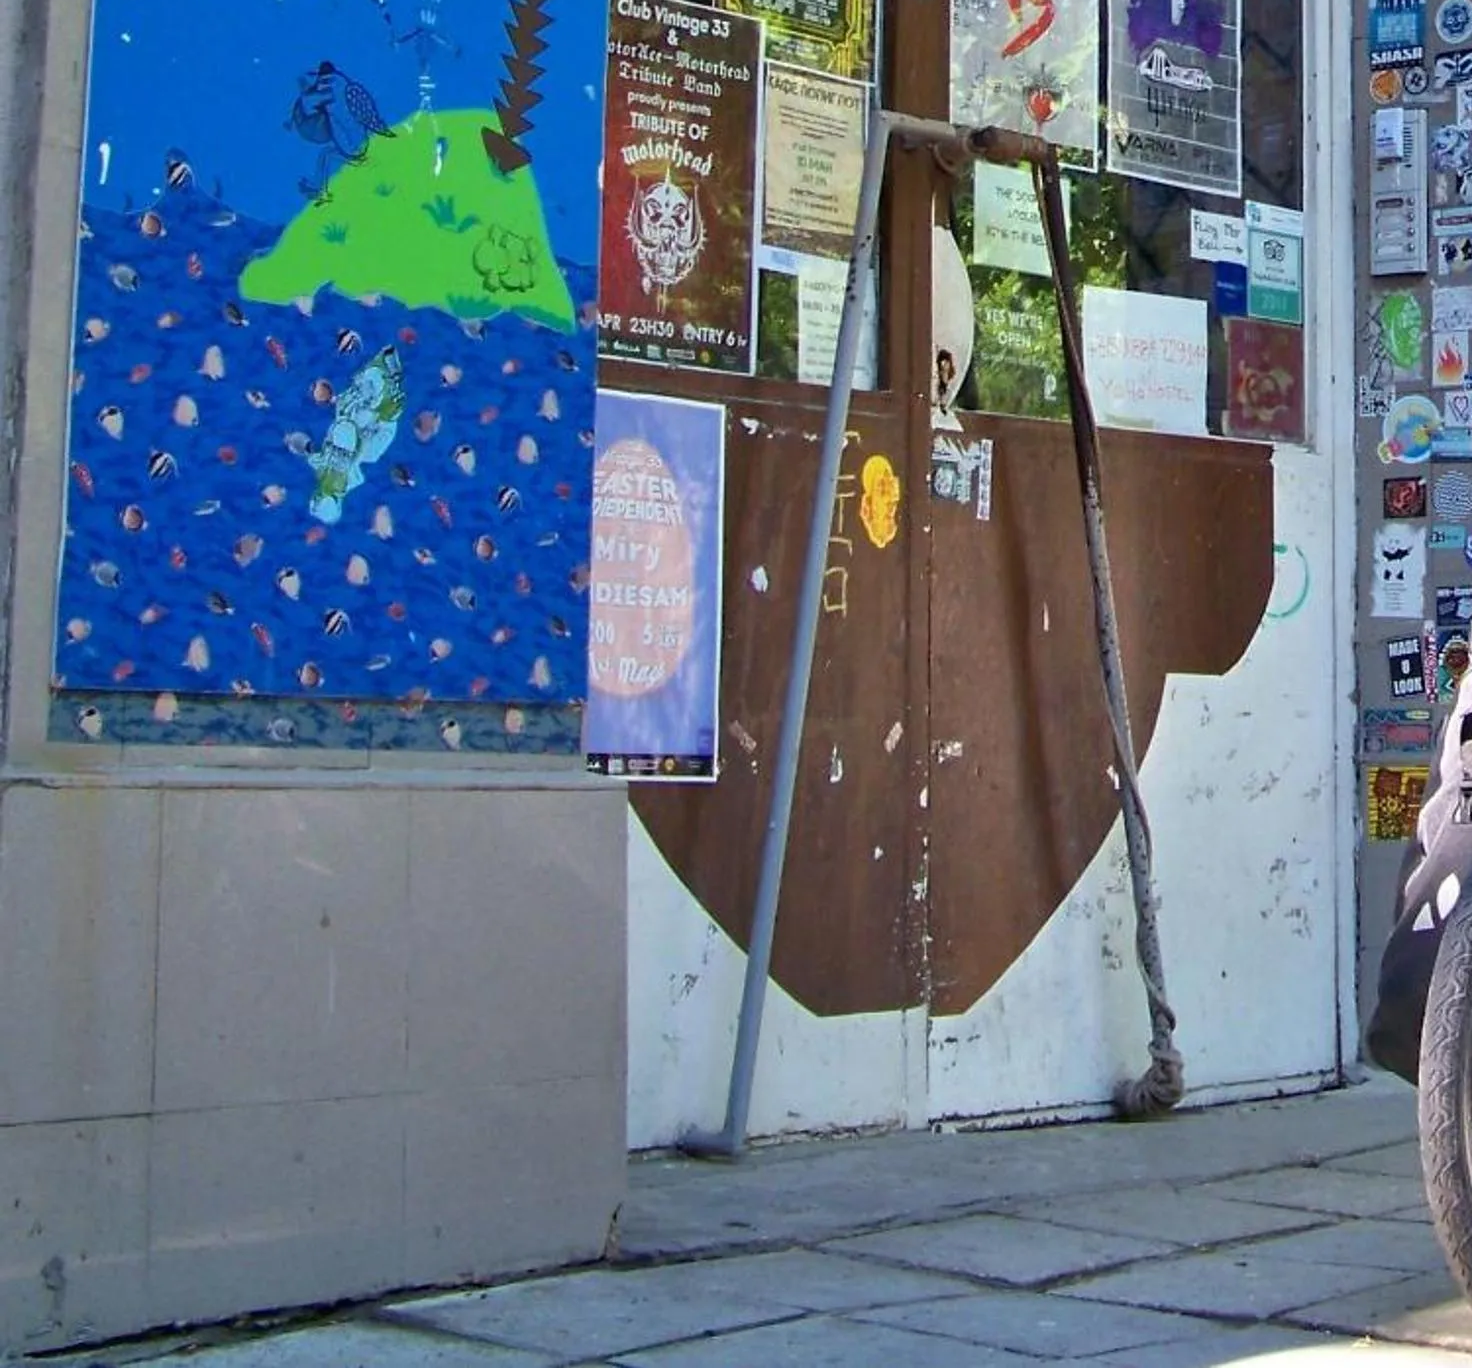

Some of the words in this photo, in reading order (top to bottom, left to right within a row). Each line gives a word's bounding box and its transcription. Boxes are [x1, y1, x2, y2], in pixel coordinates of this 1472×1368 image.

[655, 5, 710, 36] Vintage
[711, 18, 731, 38] 33
[630, 111, 686, 137] TRIBUTE
[688, 122, 711, 142] OF
[629, 317, 675, 338] 23H30
[1393, 677, 1423, 696] LOOK
